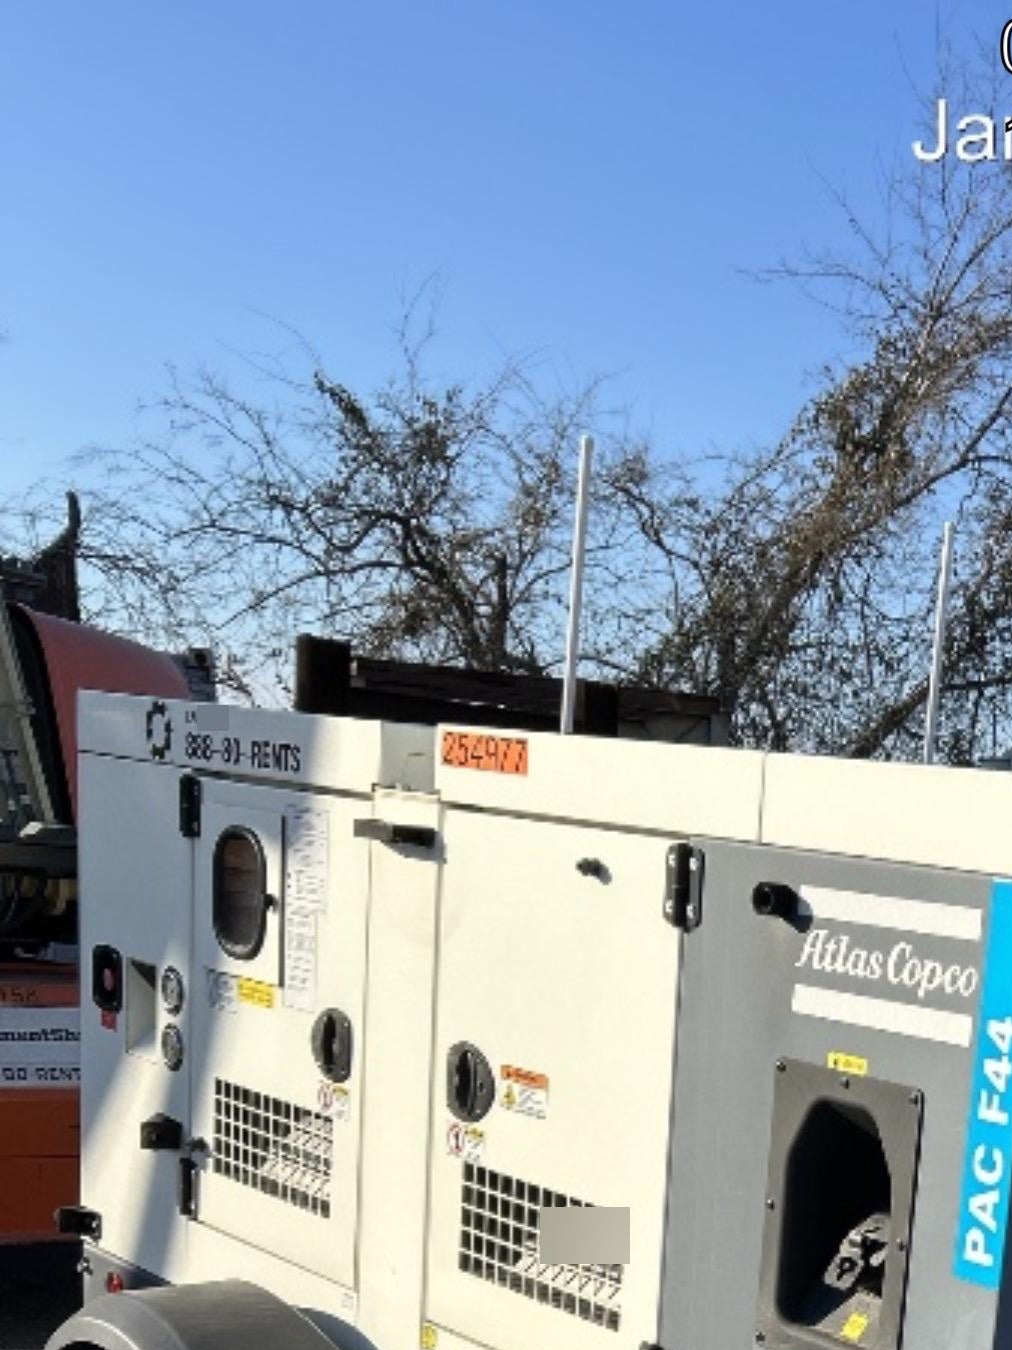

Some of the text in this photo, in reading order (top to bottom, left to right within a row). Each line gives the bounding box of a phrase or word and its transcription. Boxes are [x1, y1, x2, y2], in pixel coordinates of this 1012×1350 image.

[443, 731, 528, 773] 254977
[795, 929, 979, 998] Atlas Copco
[963, 1144, 1004, 1267] PAC
